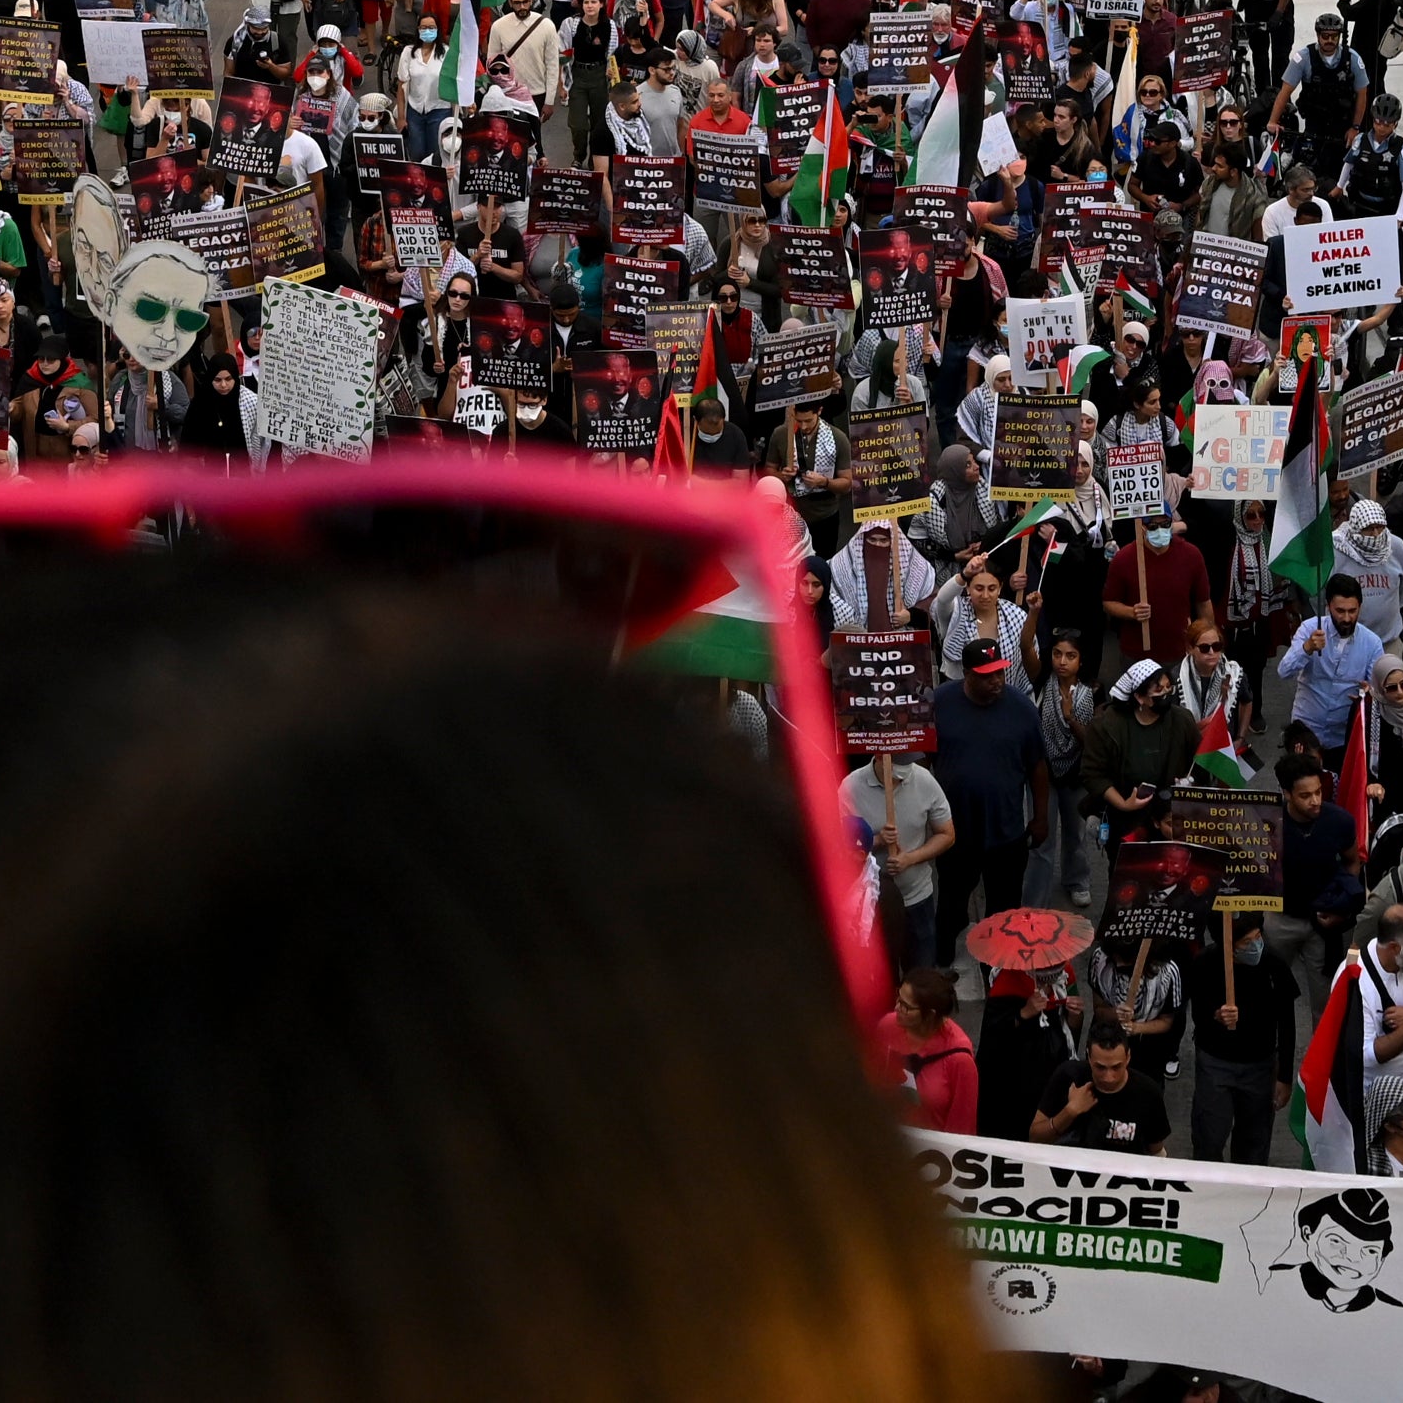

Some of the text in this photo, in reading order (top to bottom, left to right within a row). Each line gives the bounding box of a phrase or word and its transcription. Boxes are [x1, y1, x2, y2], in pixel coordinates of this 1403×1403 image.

[1089, 0, 1139, 12] TO ISRAEL
[1319, 228, 1364, 244] KILLER
[1311, 246, 1371, 262] KAMALA
[1322, 263, 1362, 278] WE'RE
[1306, 278, 1381, 297] SPEAKING!
[874, 291, 926, 303] DEMOCRATS
[880, 299, 921, 310] FUND THE
[869, 311, 932, 325] PALESTINIANS
[871, 307, 915, 318] GENOCIDE
[1023, 315, 1073, 327] SHUT THE
[1029, 326, 1071, 338] D N C
[1027, 411, 1053, 419] BOTH
[1004, 422, 1062, 432] DEMOCRATS
[1235, 410, 1287, 436] THE
[1005, 435, 1070, 444] REPUBLICANS
[998, 447, 1023, 456] HAVE
[1061, 449, 1075, 457] ON
[1109, 444, 1159, 456] STAND WITH
[1211, 437, 1284, 464] GREA
[1110, 452, 1159, 465] PALESTINE!
[1004, 460, 1067, 470] THEIR HANDS!
[1112, 468, 1135, 479] END
[1113, 477, 1159, 492] AID TO
[1114, 490, 1160, 505] ISRAEL!
[846, 634, 914, 644] FREE PALESTINE
[861, 650, 902, 662] END
[849, 665, 915, 677] U.S. AID
[870, 682, 895, 692] TO
[849, 695, 919, 707] ISRAEL
[1055, 1231, 1183, 1267] BRIGADE
